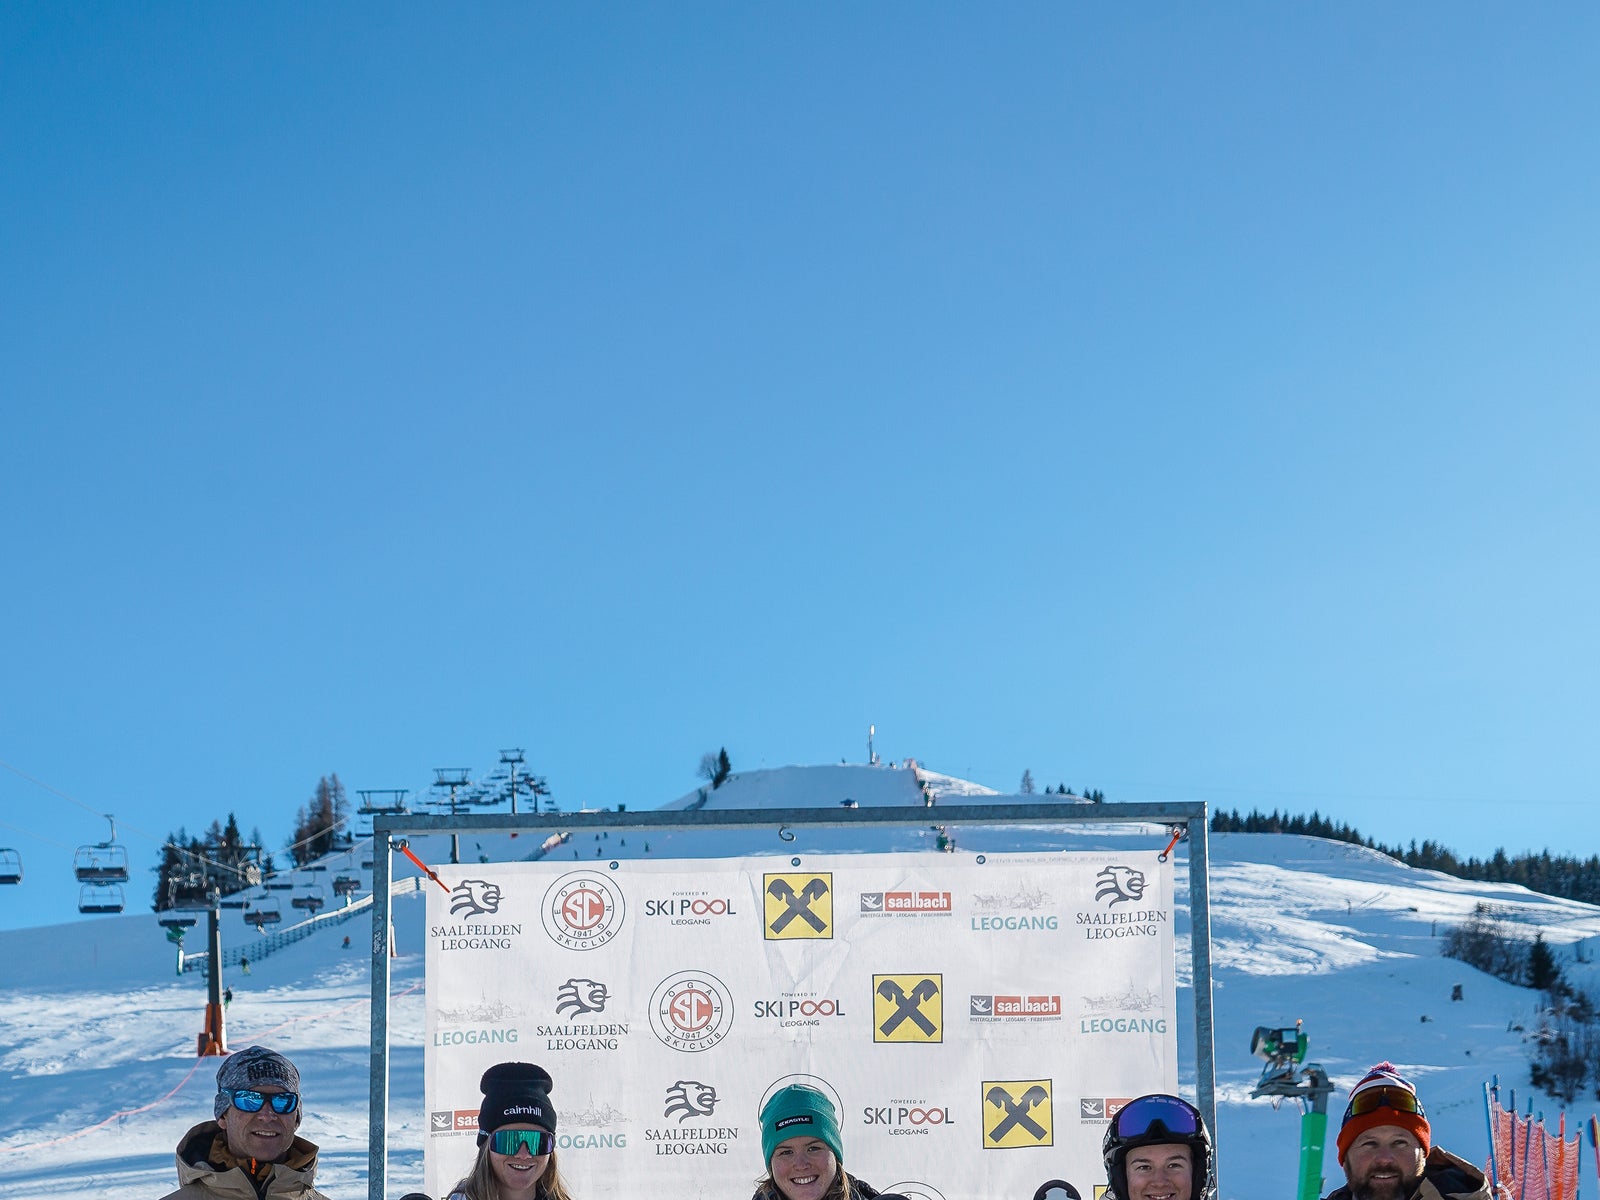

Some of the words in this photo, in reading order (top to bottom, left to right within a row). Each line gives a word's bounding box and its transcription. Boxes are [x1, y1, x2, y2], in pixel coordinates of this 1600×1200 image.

[645, 899, 675, 916] SKI
[887, 892, 949, 909] saalbach
[671, 918, 711, 926] LEOGANG
[971, 916, 1059, 931] LEOGANG
[1076, 911, 1167, 926] SAALFELDEN
[431, 924, 522, 938] SAALFELDEN
[572, 929, 592, 938] 1947
[1086, 925, 1157, 940] LEOGANG
[441, 938, 512, 951] LEOGANG
[556, 929, 613, 949] SKICLUB
[754, 1000, 783, 1018] SKI
[997, 996, 1057, 1013] saalbach
[536, 1024, 630, 1038] SAALFELDEN
[780, 1020, 820, 1028] LEOGANG
[1081, 1018, 1167, 1034] LEOGANG
[433, 1029, 519, 1047] LEOGANG
[664, 1032, 722, 1050] SKICLUB
[680, 1031, 701, 1040] 1947
[547, 1038, 619, 1051] LEOGANG
[503, 1105, 542, 1117] cairnhill
[863, 1107, 892, 1125] SKI
[645, 1128, 739, 1143] SAALFELDEN
[888, 1128, 929, 1136] LEOGANG
[556, 1133, 627, 1149] OGANG
[655, 1141, 728, 1156] LEOGANG
